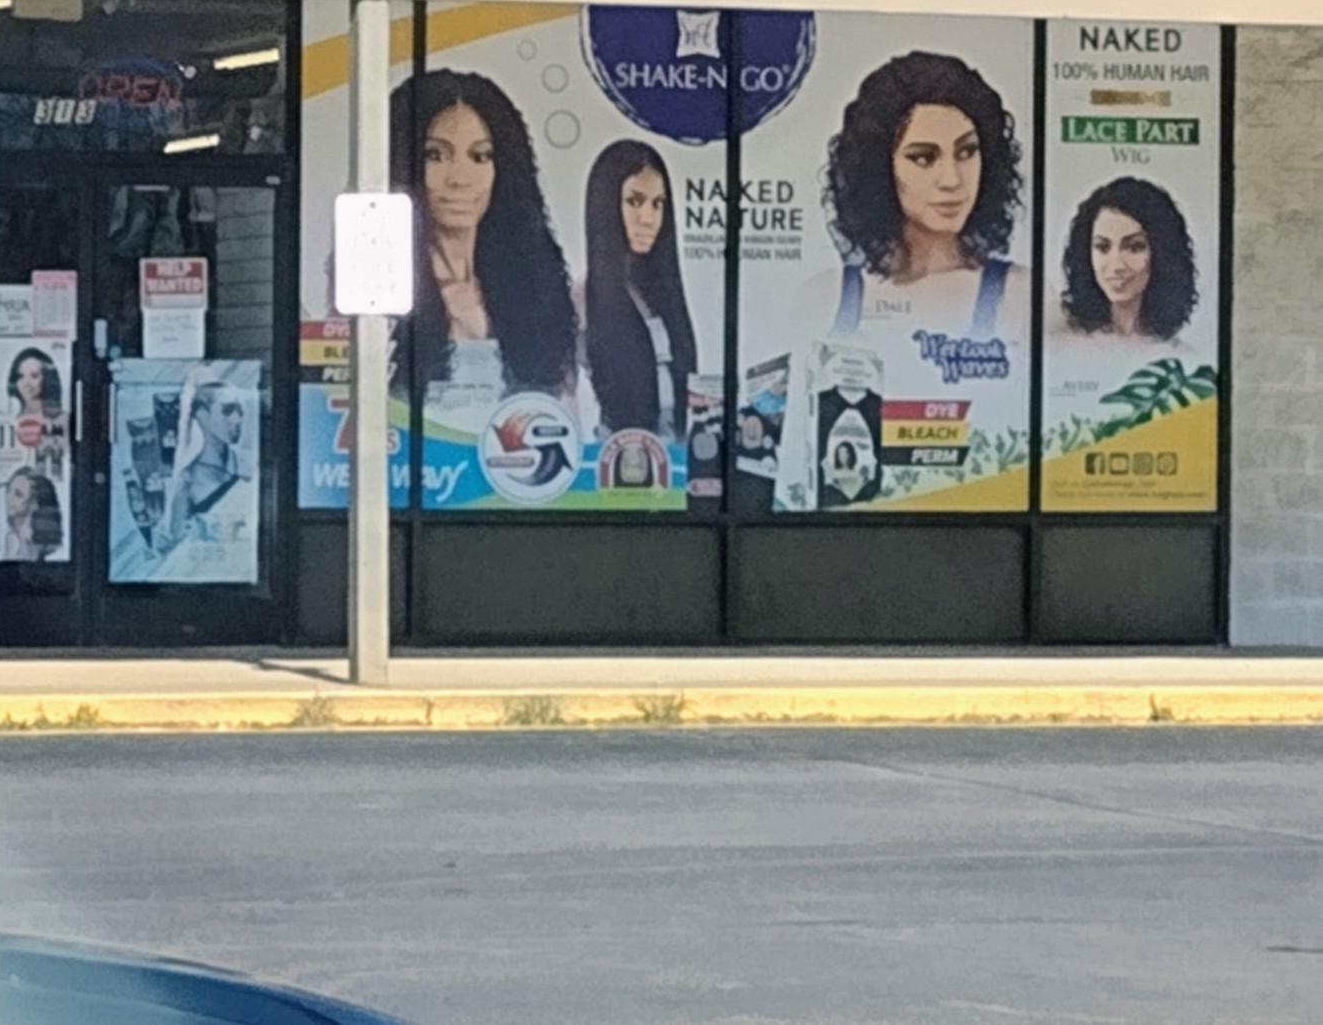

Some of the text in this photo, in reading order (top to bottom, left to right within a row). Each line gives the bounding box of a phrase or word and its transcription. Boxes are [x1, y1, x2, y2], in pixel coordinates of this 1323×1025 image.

[1079, 26, 1182, 52] NAKED
[614, 63, 784, 93] SHAKE-NGO
[1052, 61, 1210, 83] 100% HUMAN HAIR
[1068, 117, 1194, 143] LACE PART
[1111, 146, 1150, 164] WIG
[686, 178, 794, 204] NAKED
[685, 206, 803, 231] NATURE
[924, 402, 960, 418] DYE
[897, 427, 957, 439] BLEACH
[910, 449, 959, 463] PERM
